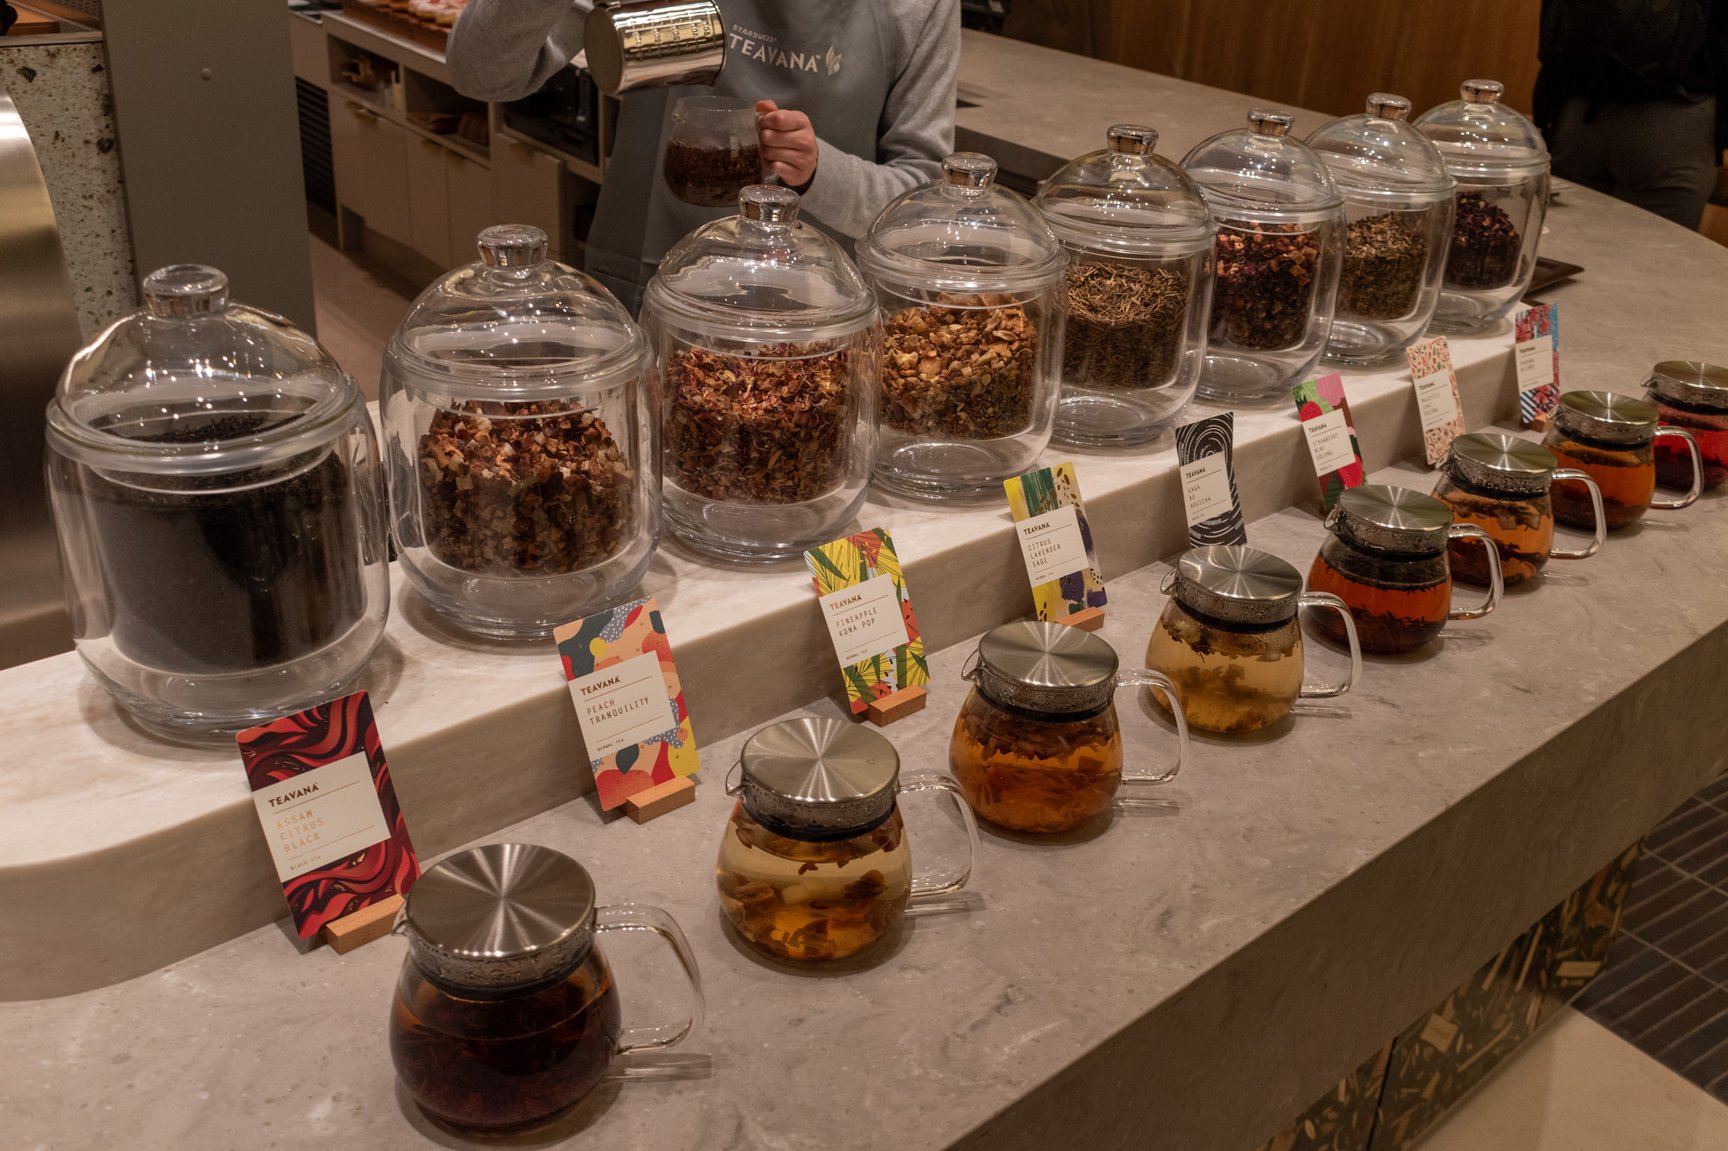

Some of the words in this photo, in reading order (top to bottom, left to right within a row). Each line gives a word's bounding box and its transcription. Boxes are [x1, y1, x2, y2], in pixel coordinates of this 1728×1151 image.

[729, 33, 819, 73] TEAVANA
[1185, 468, 1206, 479] TEAVANA
[1023, 522, 1050, 535] TEAVANA
[1028, 538, 1052, 551] CITRUS
[1030, 544, 1061, 560] LAVENDER
[1032, 557, 1048, 568] SAGE
[829, 594, 862, 611] TEAVANA
[836, 607, 878, 627] PINEAPPLE
[839, 625, 858, 637] KONA
[862, 618, 875, 629] POP
[580, 676, 620, 696] TEAVANA
[586, 699, 615, 715] PEACH
[590, 697, 649, 725] TRANQUILITY
[268, 783, 319, 808] TEAVANA
[276, 809, 313, 830] ASSAM
[280, 818, 325, 841] CITRUS
[284, 832, 321, 852] BLACK
